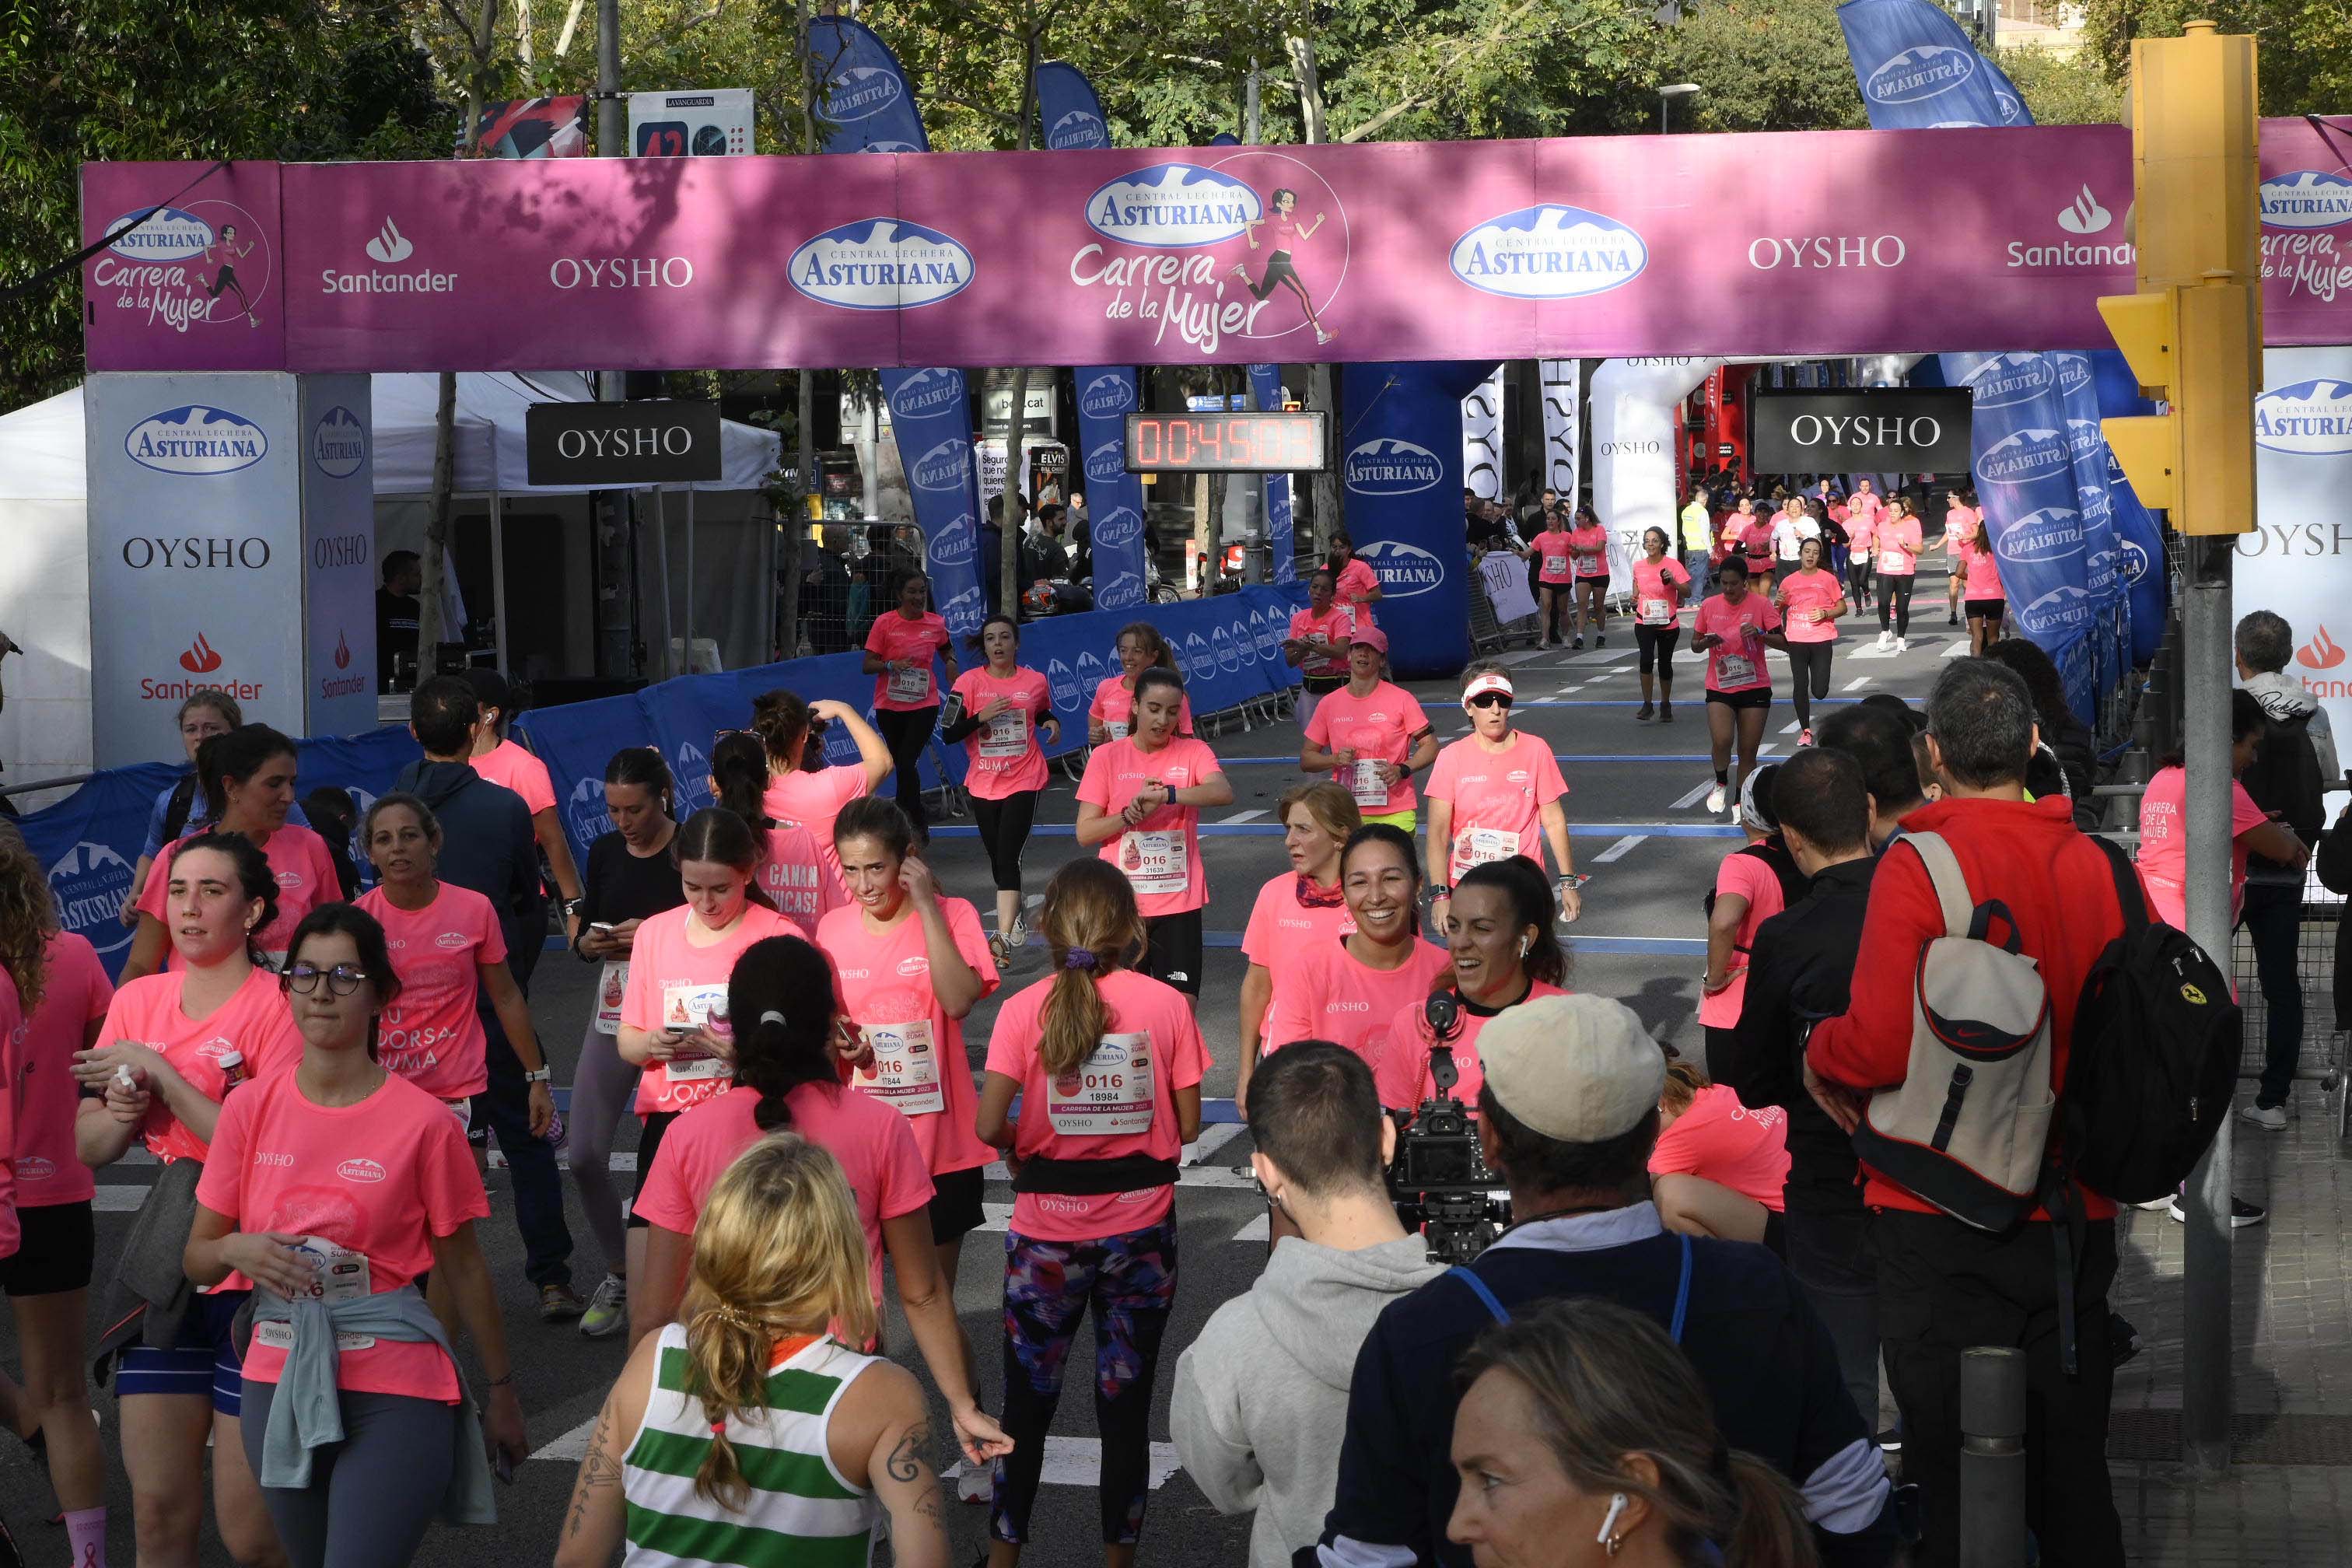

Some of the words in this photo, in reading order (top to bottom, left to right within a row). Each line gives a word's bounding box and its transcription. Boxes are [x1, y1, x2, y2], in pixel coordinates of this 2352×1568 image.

[1187, 191, 1244, 200] LECHERA
[1098, 195, 1248, 226] ASTURIANA
[112, 227, 206, 247] ASTURIANA
[1495, 237, 1555, 247] CENTRAL
[1563, 236, 1626, 246] LECHERA
[2261, 233, 2334, 255] arrera
[831, 249, 890, 259] CENTRAL
[894, 249, 954, 258] LECHERA
[1465, 241, 1633, 275] ASTURIANA
[1748, 235, 1906, 269] OYSHO
[94, 258, 185, 286] Carrera
[550, 256, 694, 289] OYSHO
[802, 253, 961, 286] ASTURIANA
[1070, 243, 1216, 286] Carrera
[322, 269, 457, 293] Santander
[2279, 257, 2292, 278] la
[2289, 251, 2352, 302] Muje
[117, 289, 134, 308] de
[138, 286, 149, 308] la
[148, 285, 220, 332] Mujer
[1106, 289, 1132, 319] de
[1139, 287, 1158, 319] la
[1154, 282, 1270, 354] Mujer
[1790, 415, 1941, 446] OYSHO
[2256, 409, 2352, 436] ASTURI
[136, 431, 257, 457] ASTURIANA
[317, 433, 362, 461] ASTURIANA
[558, 426, 692, 458] OYSHO
[1601, 440, 1660, 456] OYSHO
[1041, 453, 1065, 464] ELVIS
[983, 467, 996, 476] que
[1348, 462, 1436, 482] ASTURIANA
[983, 476, 1005, 485] quiere
[122, 537, 271, 569] OYSHO
[315, 534, 367, 569] OYSHO
[1377, 569, 1437, 583] URIANA
[322, 675, 366, 699] Santander
[978, 759, 1010, 771] SUMA
[1118, 772, 1146, 780] OYSHO
[2144, 803, 2177, 815] CARRERA
[2146, 814, 2154, 825] DE
[2157, 815, 2166, 826] LA
[2144, 826, 2168, 838] MUJER
[1475, 850, 1495, 860] 016
[769, 863, 817, 888] GANAN
[1279, 919, 1311, 929] OYSHO
[658, 978, 691, 989] OYSHO
[1326, 1002, 1369, 1013] OYSHO
[676, 1064, 705, 1073] OYSHO
[878, 1061, 902, 1073] 016
[1085, 1075, 1122, 1088] 016
[1120, 1117, 1149, 1125] Santander
[341, 1165, 382, 1178] ASTURIANA
[1040, 1199, 1088, 1213] OYSHO
[265, 1328, 292, 1339] OYSHO
